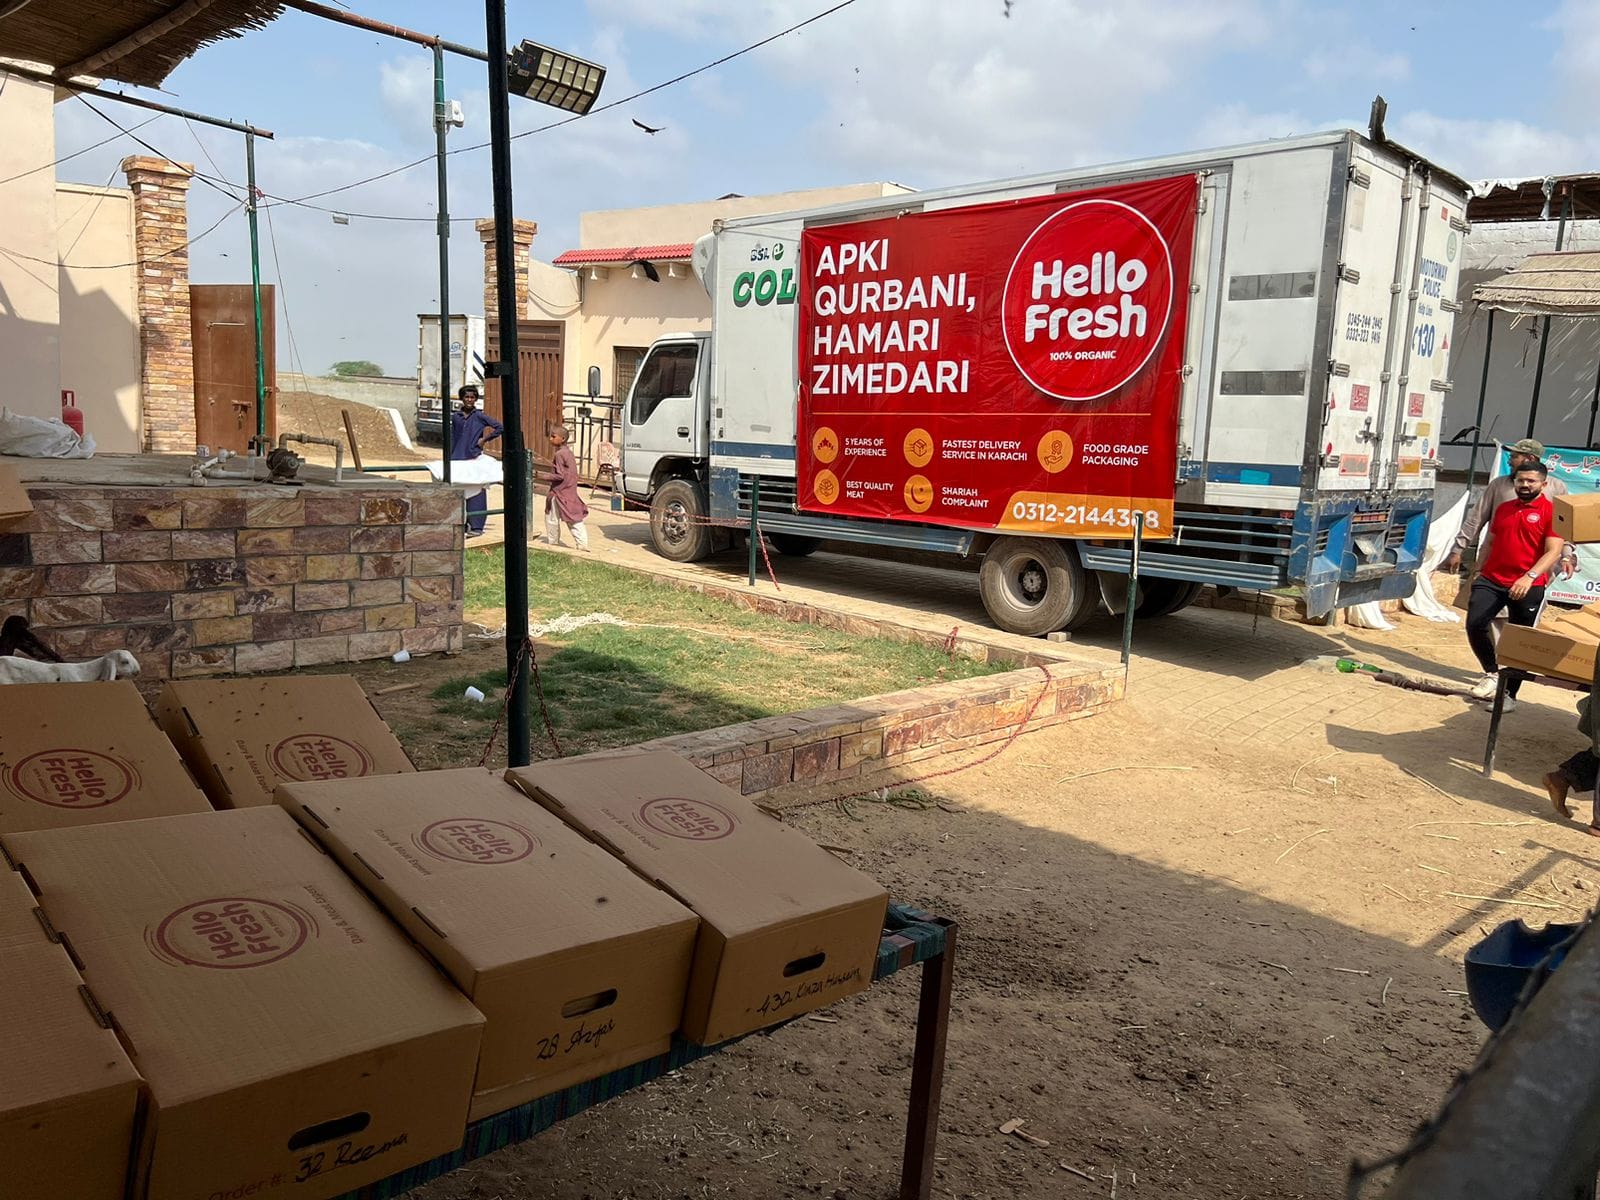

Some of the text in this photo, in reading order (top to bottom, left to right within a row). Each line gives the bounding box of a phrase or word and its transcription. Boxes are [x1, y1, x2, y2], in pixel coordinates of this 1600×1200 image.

[815, 238, 889, 277] APKI
[732, 267, 799, 308] COL
[1031, 250, 1148, 300] Hello
[1422, 278, 1442, 299] POLICE
[814, 272, 976, 316] QURBANI,
[1024, 293, 1147, 343] Fresh
[813, 318, 940, 356] HAMARI
[1417, 323, 1435, 358] 130
[1049, 350, 1117, 361] 100% ORGANIC
[812, 359, 970, 395] ZIMEDARI
[844, 448, 887, 457] EXPERIENCE
[845, 438, 884, 447] 5 YEARS OF
[942, 439, 1021, 450] FASTEST DELIVERY
[942, 451, 1028, 461] SERVICE IN KARACHI
[1083, 443, 1149, 455] FOOD GRADE
[1082, 455, 1139, 467] PACKAGING
[846, 481, 894, 492] BEST QUALITY
[846, 490, 865, 499] MEAT
[942, 486, 978, 497] SHARIAH
[942, 497, 989, 508] COMPLAINT
[1551, 591, 1578, 599] BEHIND
[293, 742, 331, 780] Fresh
[314, 740, 348, 778] Hello
[39, 758, 84, 803] Fresh
[67, 757, 106, 798] Hello
[654, 804, 705, 836] Fresh
[673, 802, 720, 833] Hello
[440, 825, 495, 860] Fresh
[464, 824, 514, 855] Hello
[191, 911, 246, 960] Hello
[218, 902, 280, 954] Fresh
[536, 1032, 560, 1060] 28
[295, 1151, 326, 1183] 32
